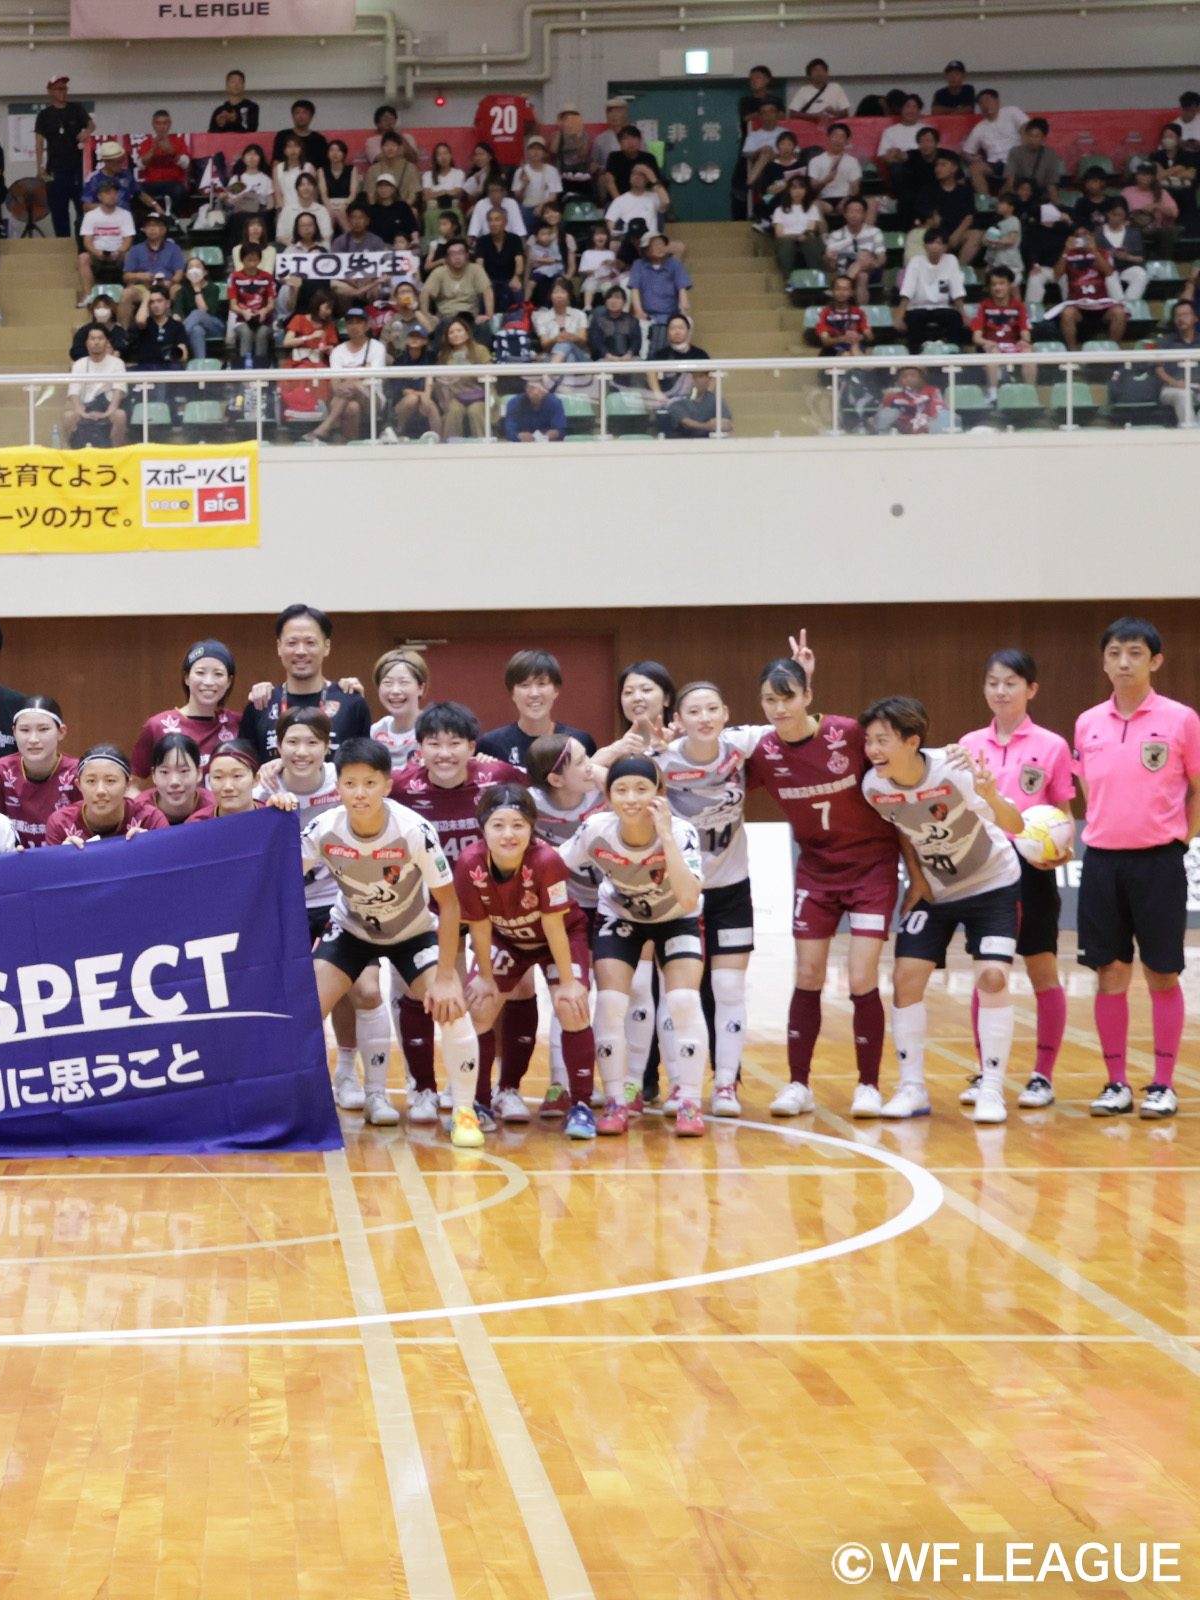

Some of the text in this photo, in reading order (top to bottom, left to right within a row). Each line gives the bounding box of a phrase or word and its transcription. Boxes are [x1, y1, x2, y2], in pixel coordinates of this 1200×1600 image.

[158, 2, 270, 18] F.LEAGUE
[490, 105, 518, 135] 20
[146, 464, 246, 485] スポーツくじ
[811, 801, 831, 830] 7
[706, 823, 732, 852] 14
